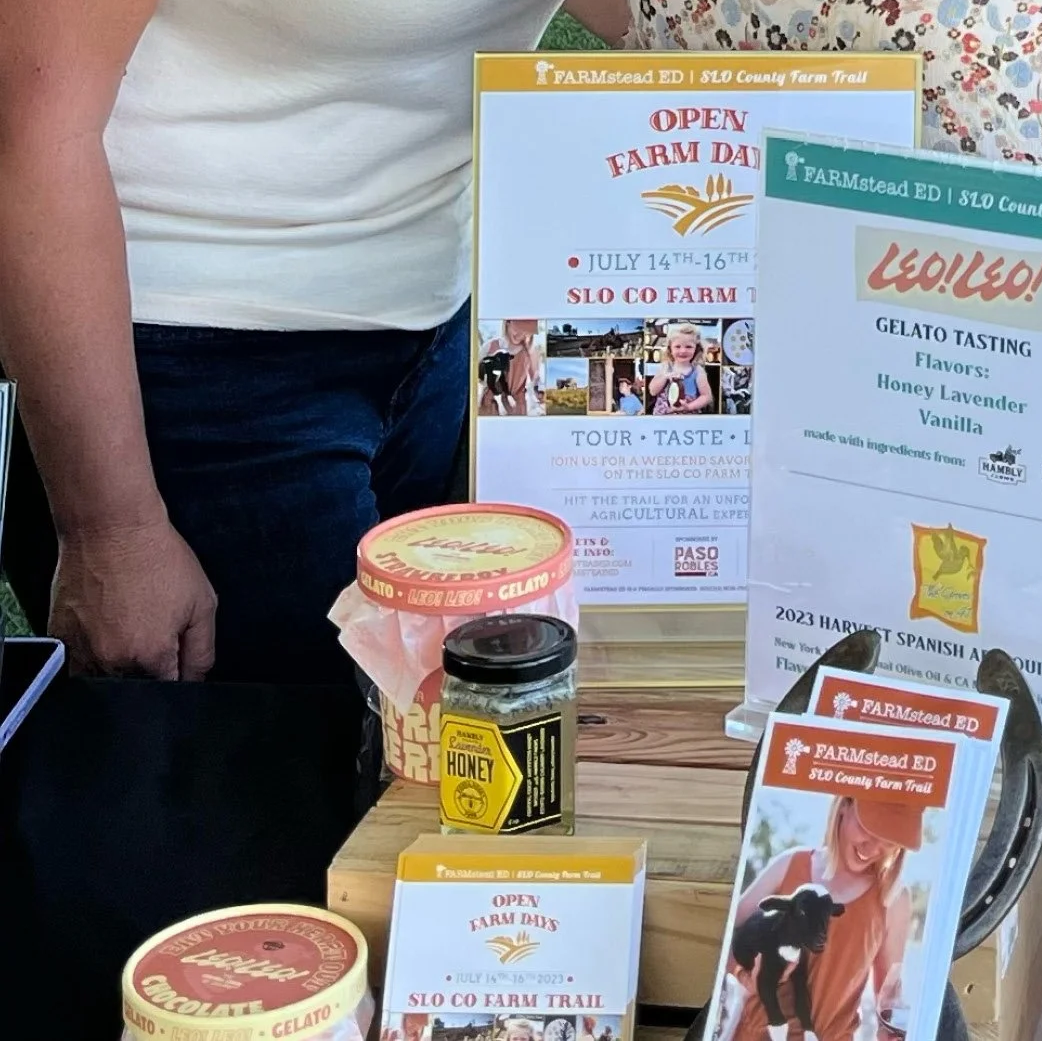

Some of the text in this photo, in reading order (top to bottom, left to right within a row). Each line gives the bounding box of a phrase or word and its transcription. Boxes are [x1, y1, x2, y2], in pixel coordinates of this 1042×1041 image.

[553, 69, 868, 87] FARMstead ED SLO County Farm Trail
[649, 107, 748, 132] OPEN
[605, 140, 701, 178] FARM
[803, 165, 910, 196] FARMstead
[913, 182, 942, 203] ED
[958, 189, 994, 211] SLO
[588, 253, 641, 273] JULY
[566, 286, 615, 305] SLO
[622, 287, 658, 305] CO
[667, 287, 738, 304] FARM
[875, 316, 1032, 358] GELATO TASTING
[915, 351, 990, 379] Flavors:
[876, 373, 1028, 414] Honey Lavender
[919, 408, 984, 436] Vanilla
[571, 429, 723, 447] TOUR TASTE
[803, 427, 837, 443] made
[838, 433, 865, 449] with
[867, 438, 932, 462] ingredients
[582, 456, 598, 467] US
[601, 456, 626, 466] FOR
[629, 456, 639, 466] A
[641, 455, 707, 466] WEEKEND
[603, 469, 623, 480] ON
[628, 469, 654, 479] THE
[705, 469, 740, 479] FARM
[564, 495, 588, 506] HIT
[592, 495, 618, 506] THE
[623, 495, 663, 505] TRAIL
[664, 495, 689, 505] FOR
[692, 495, 712, 505] AN
[674, 545, 719, 561] PASO
[674, 561, 719, 571] ROBLES
[497, 571, 549, 601] GELATO
[775, 605, 815, 626] 2023
[896, 631, 965, 659] SPANISH
[895, 660, 923, 676] Olive
[925, 670, 941, 682] Oil
[860, 698, 980, 733] FARMstead ED
[446, 750, 495, 784] HONEY
[813, 743, 938, 773] FARMstead ED
[808, 767, 932, 794] SLO County Farm Trail
[492, 893, 541, 908] OPEN
[469, 912, 560, 932] FARM DAYS
[456, 972, 482, 984] JULY
[537, 973, 564, 984] 2023
[140, 974, 266, 1018] CHOCOLATE
[407, 992, 605, 1008] SLO CO FARM TRAIL
[271, 1004, 332, 1039] GELATO
